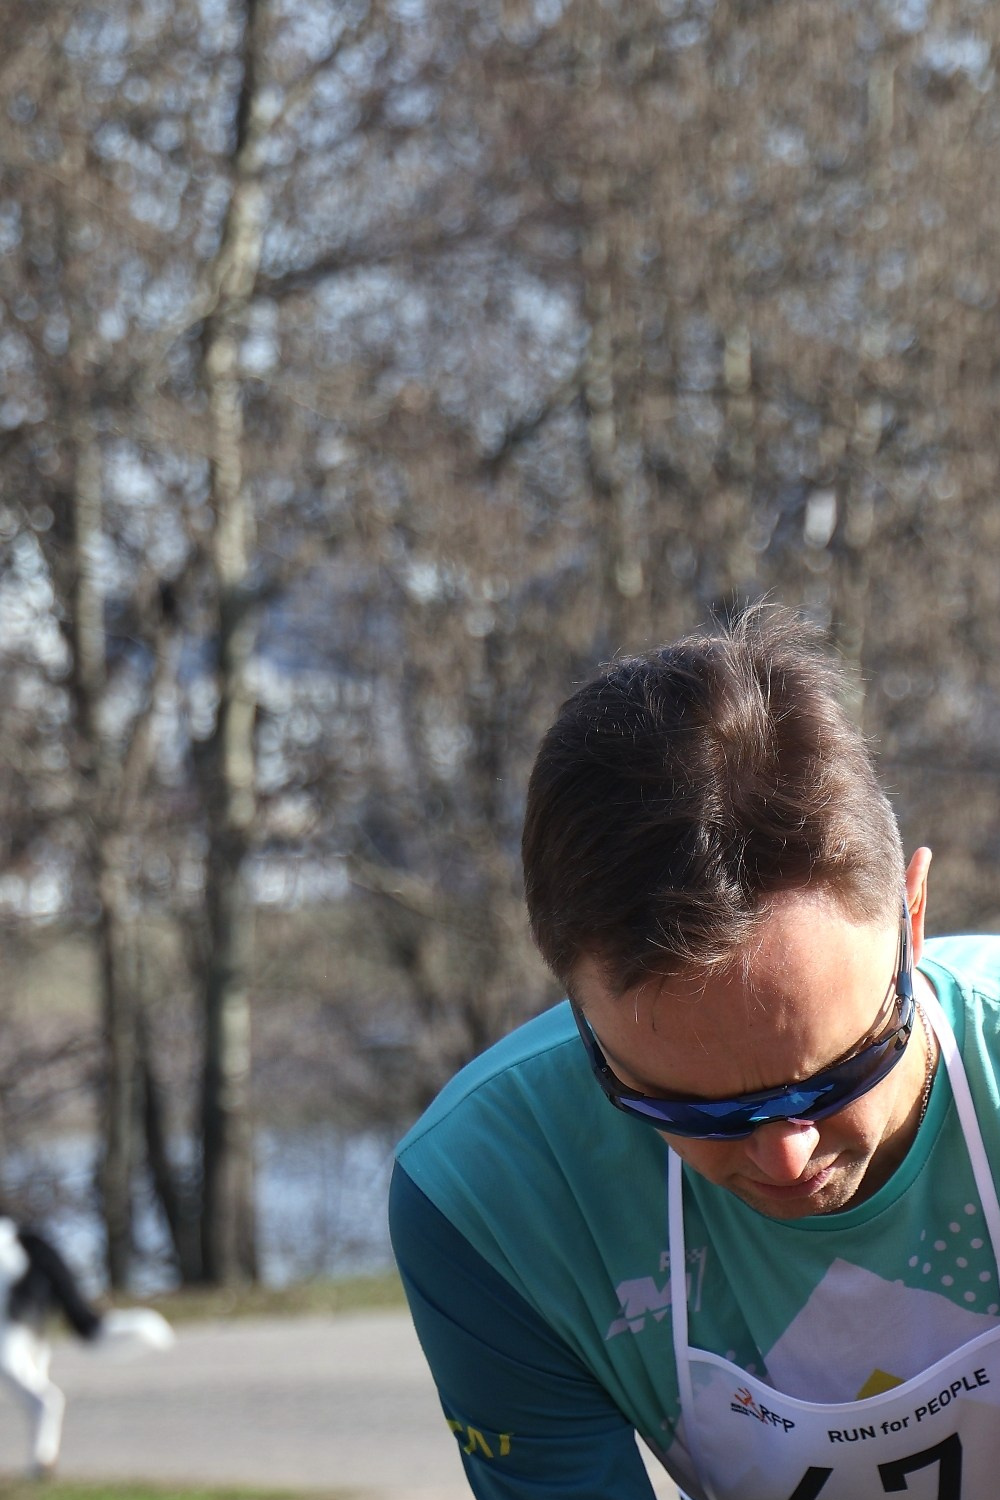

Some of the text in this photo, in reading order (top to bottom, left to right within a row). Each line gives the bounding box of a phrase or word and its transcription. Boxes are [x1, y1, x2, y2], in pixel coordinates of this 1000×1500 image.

[759, 1404, 795, 1433] RFP
[828, 1368, 990, 1443] RUN for PEOPLE
